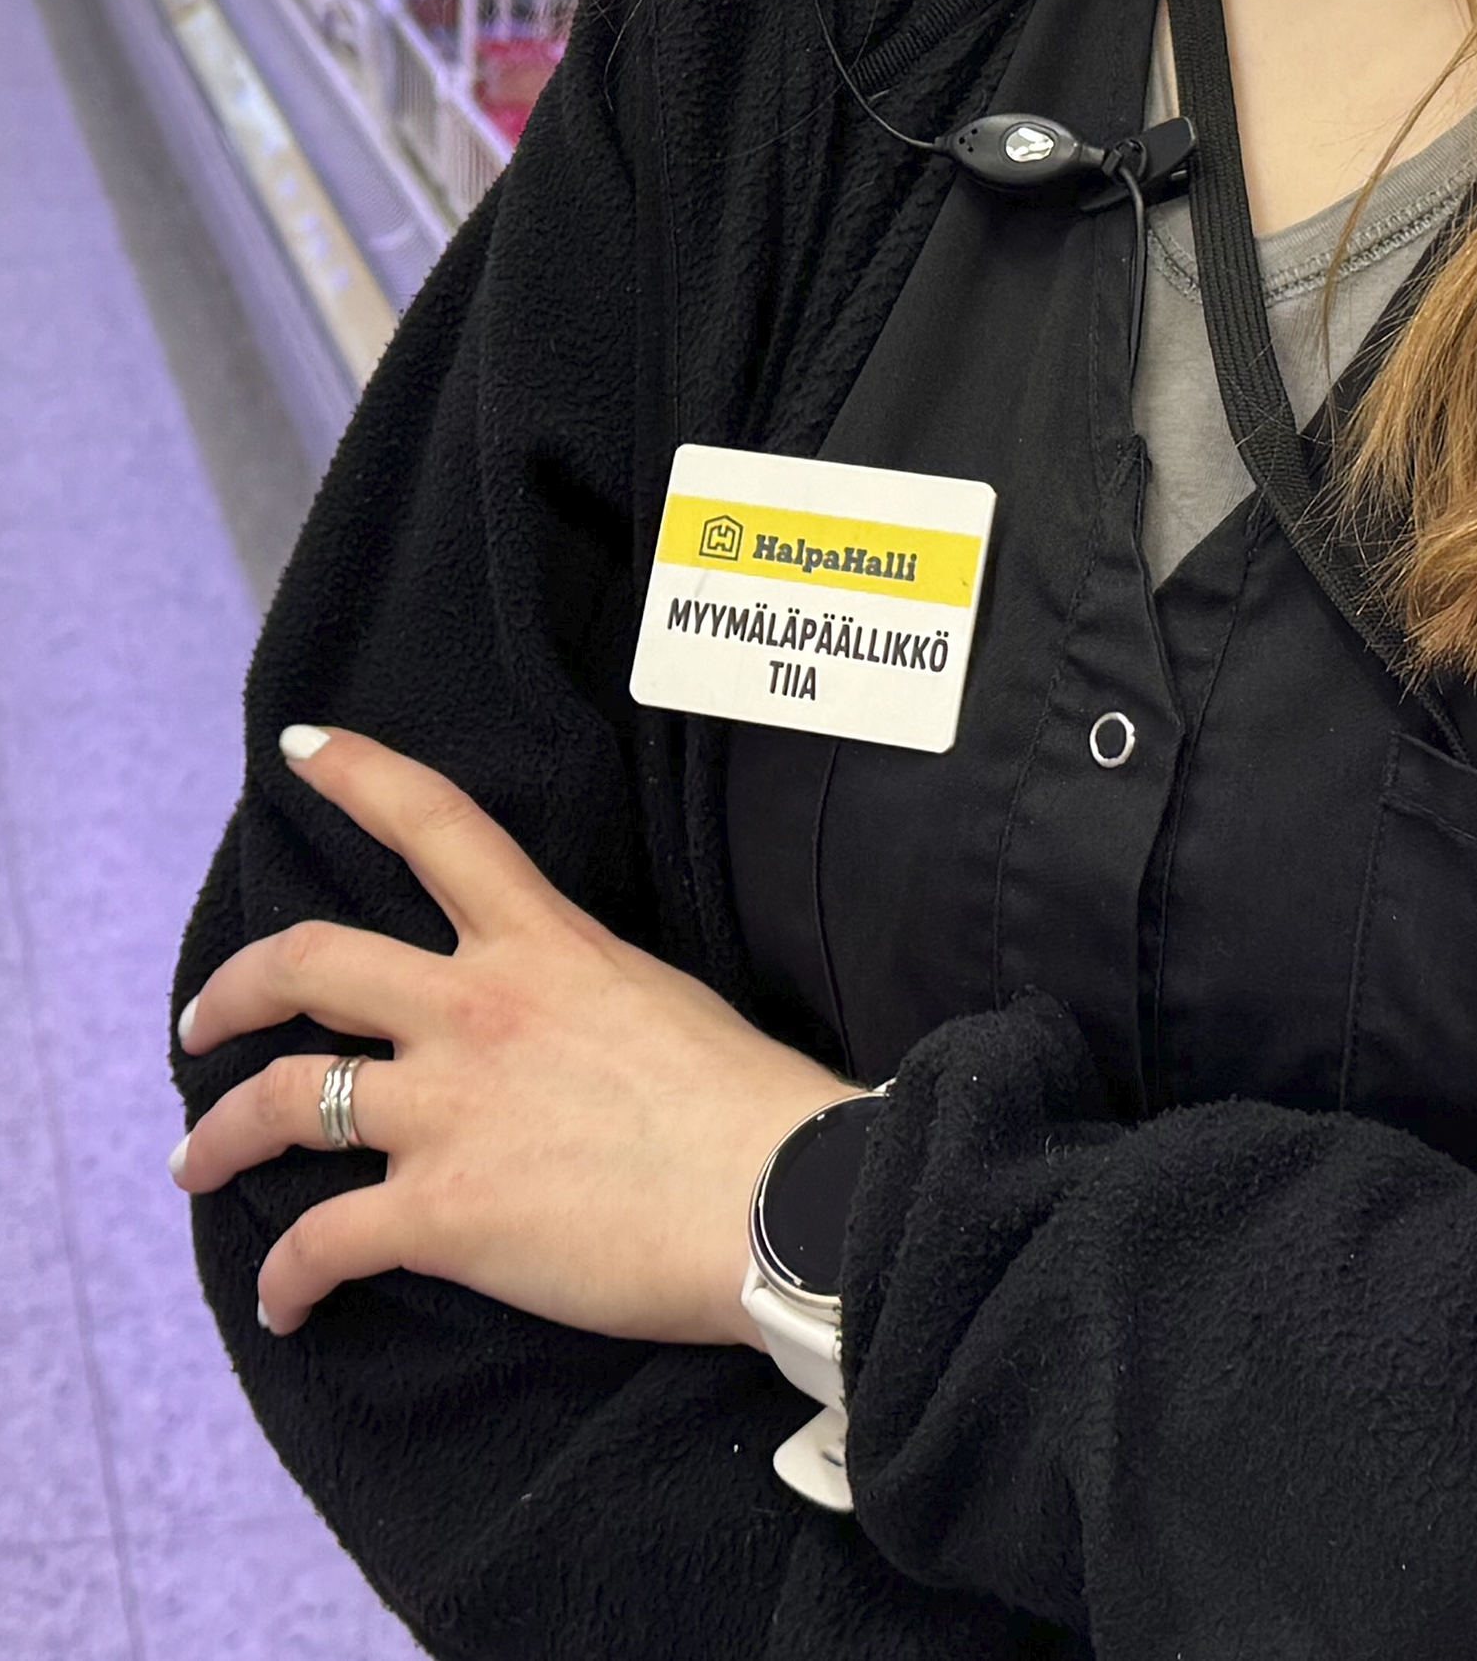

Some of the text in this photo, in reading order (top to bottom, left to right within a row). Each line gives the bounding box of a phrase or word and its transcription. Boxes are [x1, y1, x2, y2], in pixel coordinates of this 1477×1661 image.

[752, 533, 919, 583] HalpaHalli
[666, 596, 950, 673] MYYMÄLÄPÄÄLLIKKÖ
[768, 660, 817, 701] TIIA
